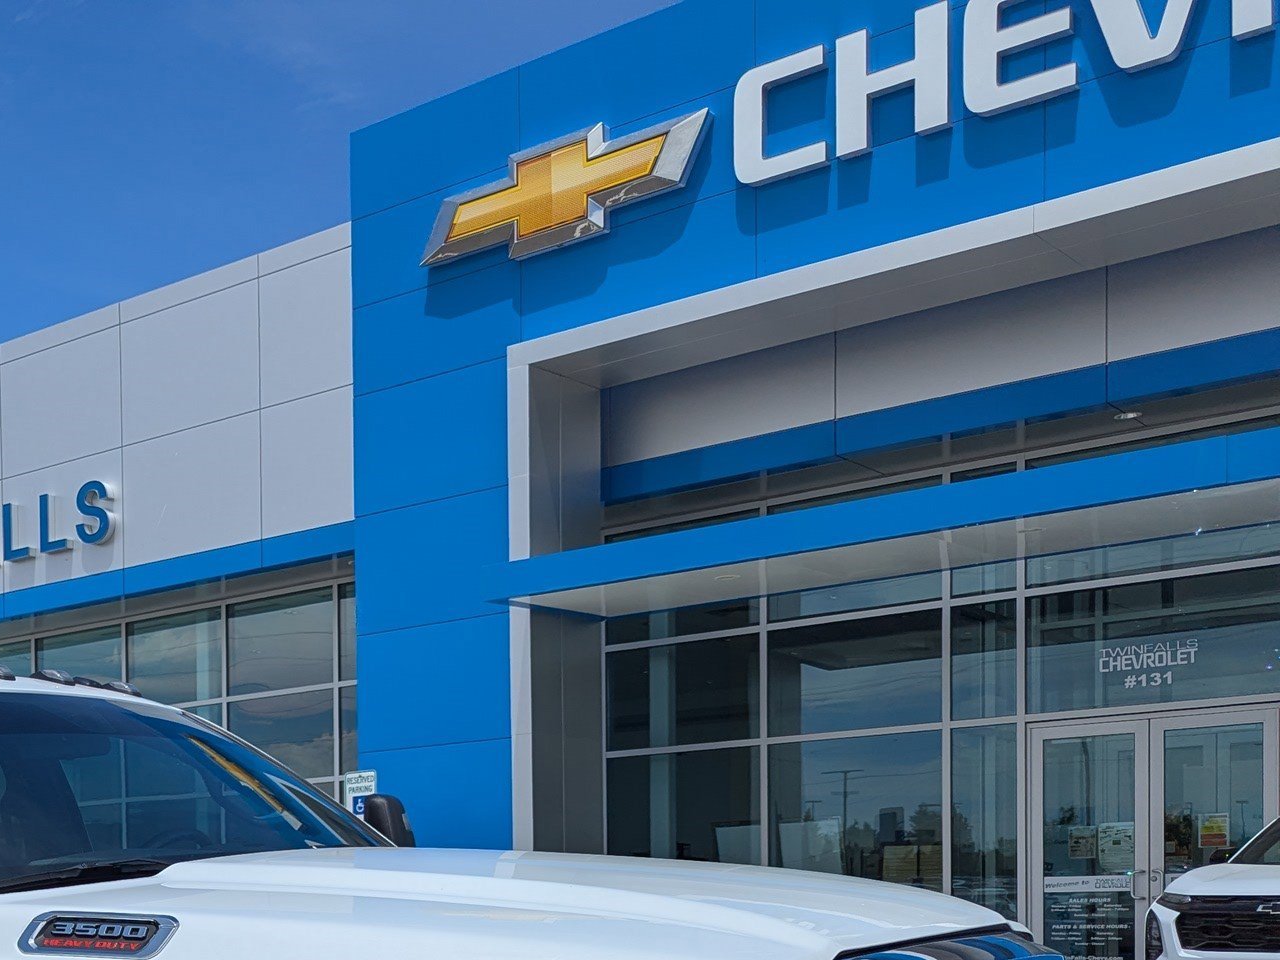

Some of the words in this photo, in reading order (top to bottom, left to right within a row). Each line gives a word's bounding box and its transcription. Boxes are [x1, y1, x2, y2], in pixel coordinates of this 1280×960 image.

[733, 0, 1276, 186] CHEV
[1099, 647, 1198, 673] CHEVROLET
[1124, 671, 1173, 689] #131
[346, 774, 375, 785] RESERVED
[348, 785, 373, 795] PARKING
[1045, 881, 1080, 889] Welcome
[51, 921, 149, 939] 3500
[42, 938, 92, 949] HEAVY
[94, 940, 142, 950] DUTY
